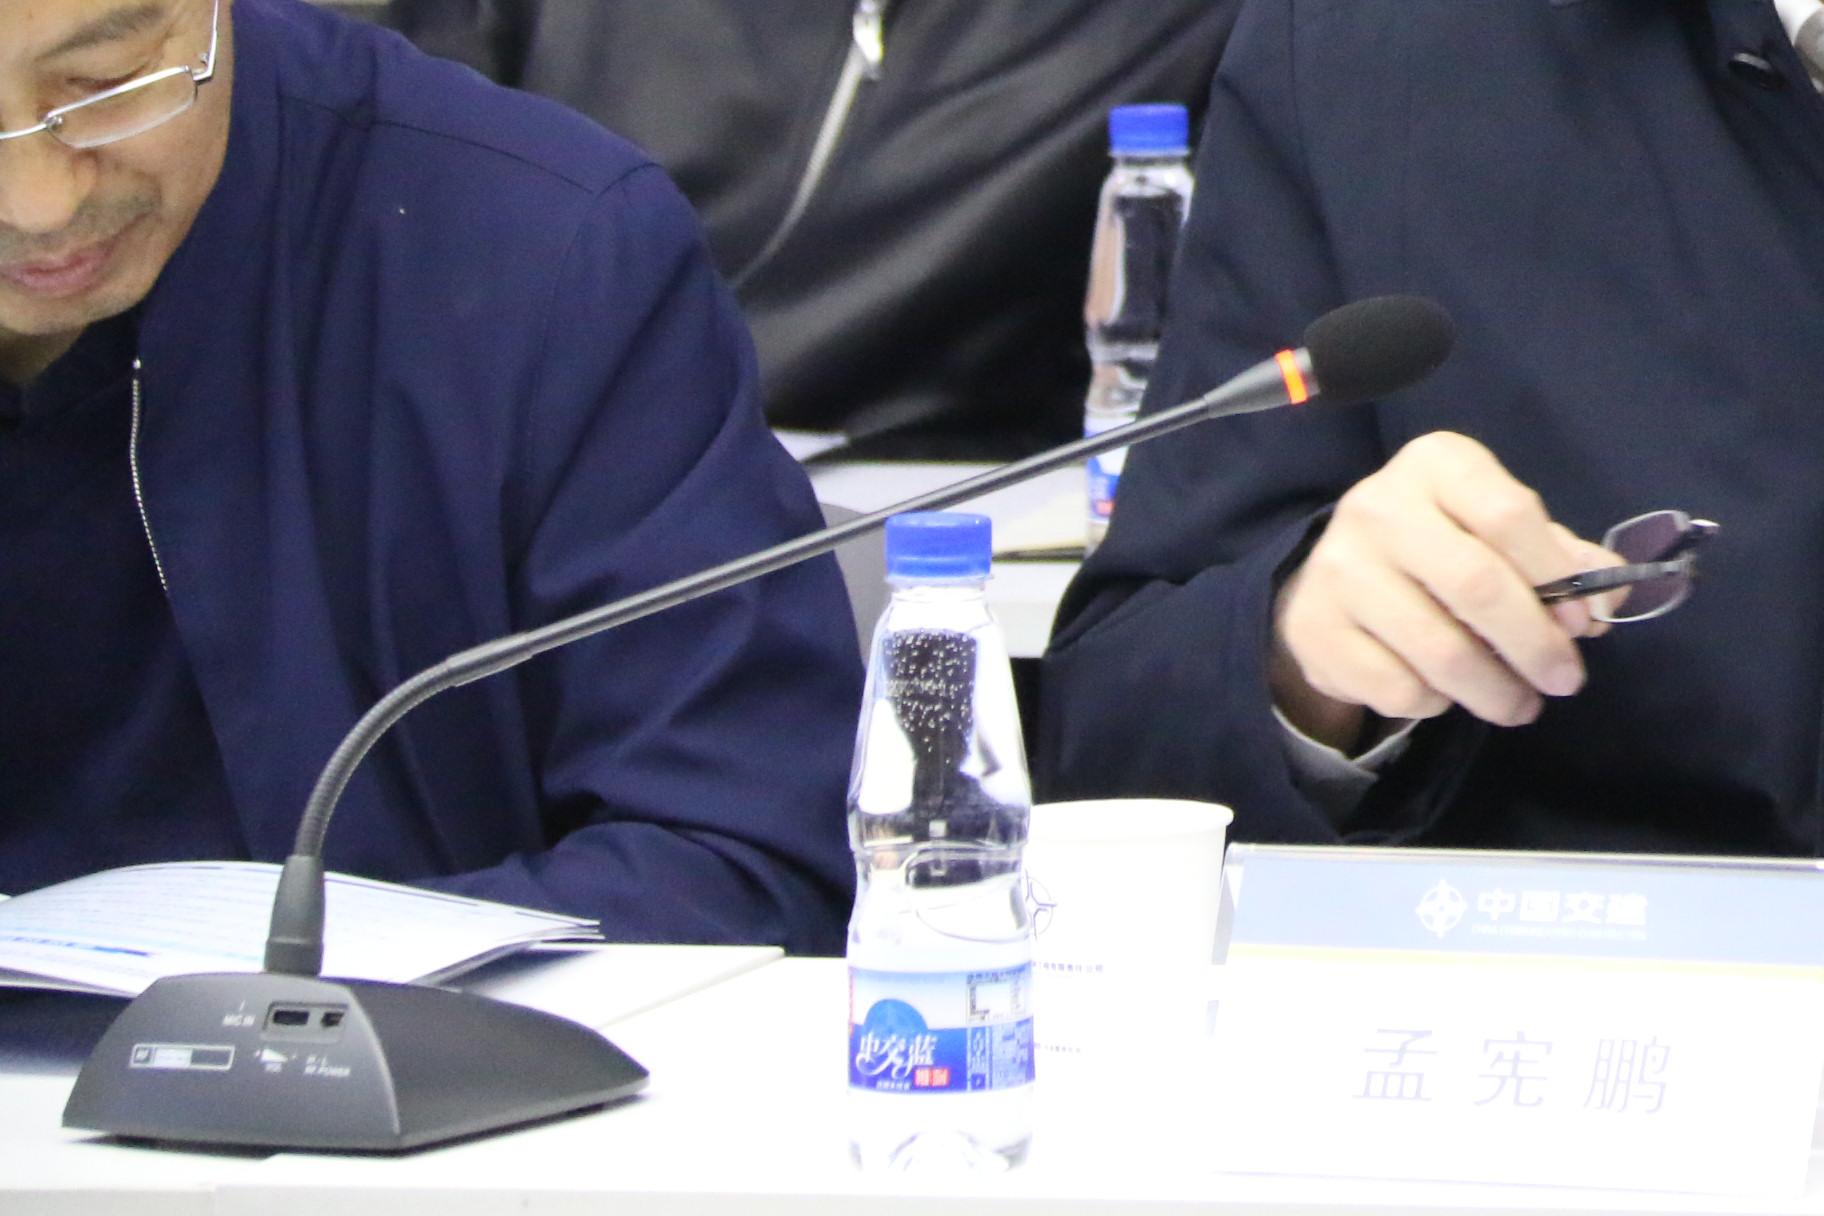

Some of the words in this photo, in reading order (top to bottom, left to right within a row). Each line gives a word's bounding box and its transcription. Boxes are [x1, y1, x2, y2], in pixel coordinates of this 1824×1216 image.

[1476, 887, 1649, 927] 中国交建
[1351, 1027, 1671, 1115] 孟宪鹏
